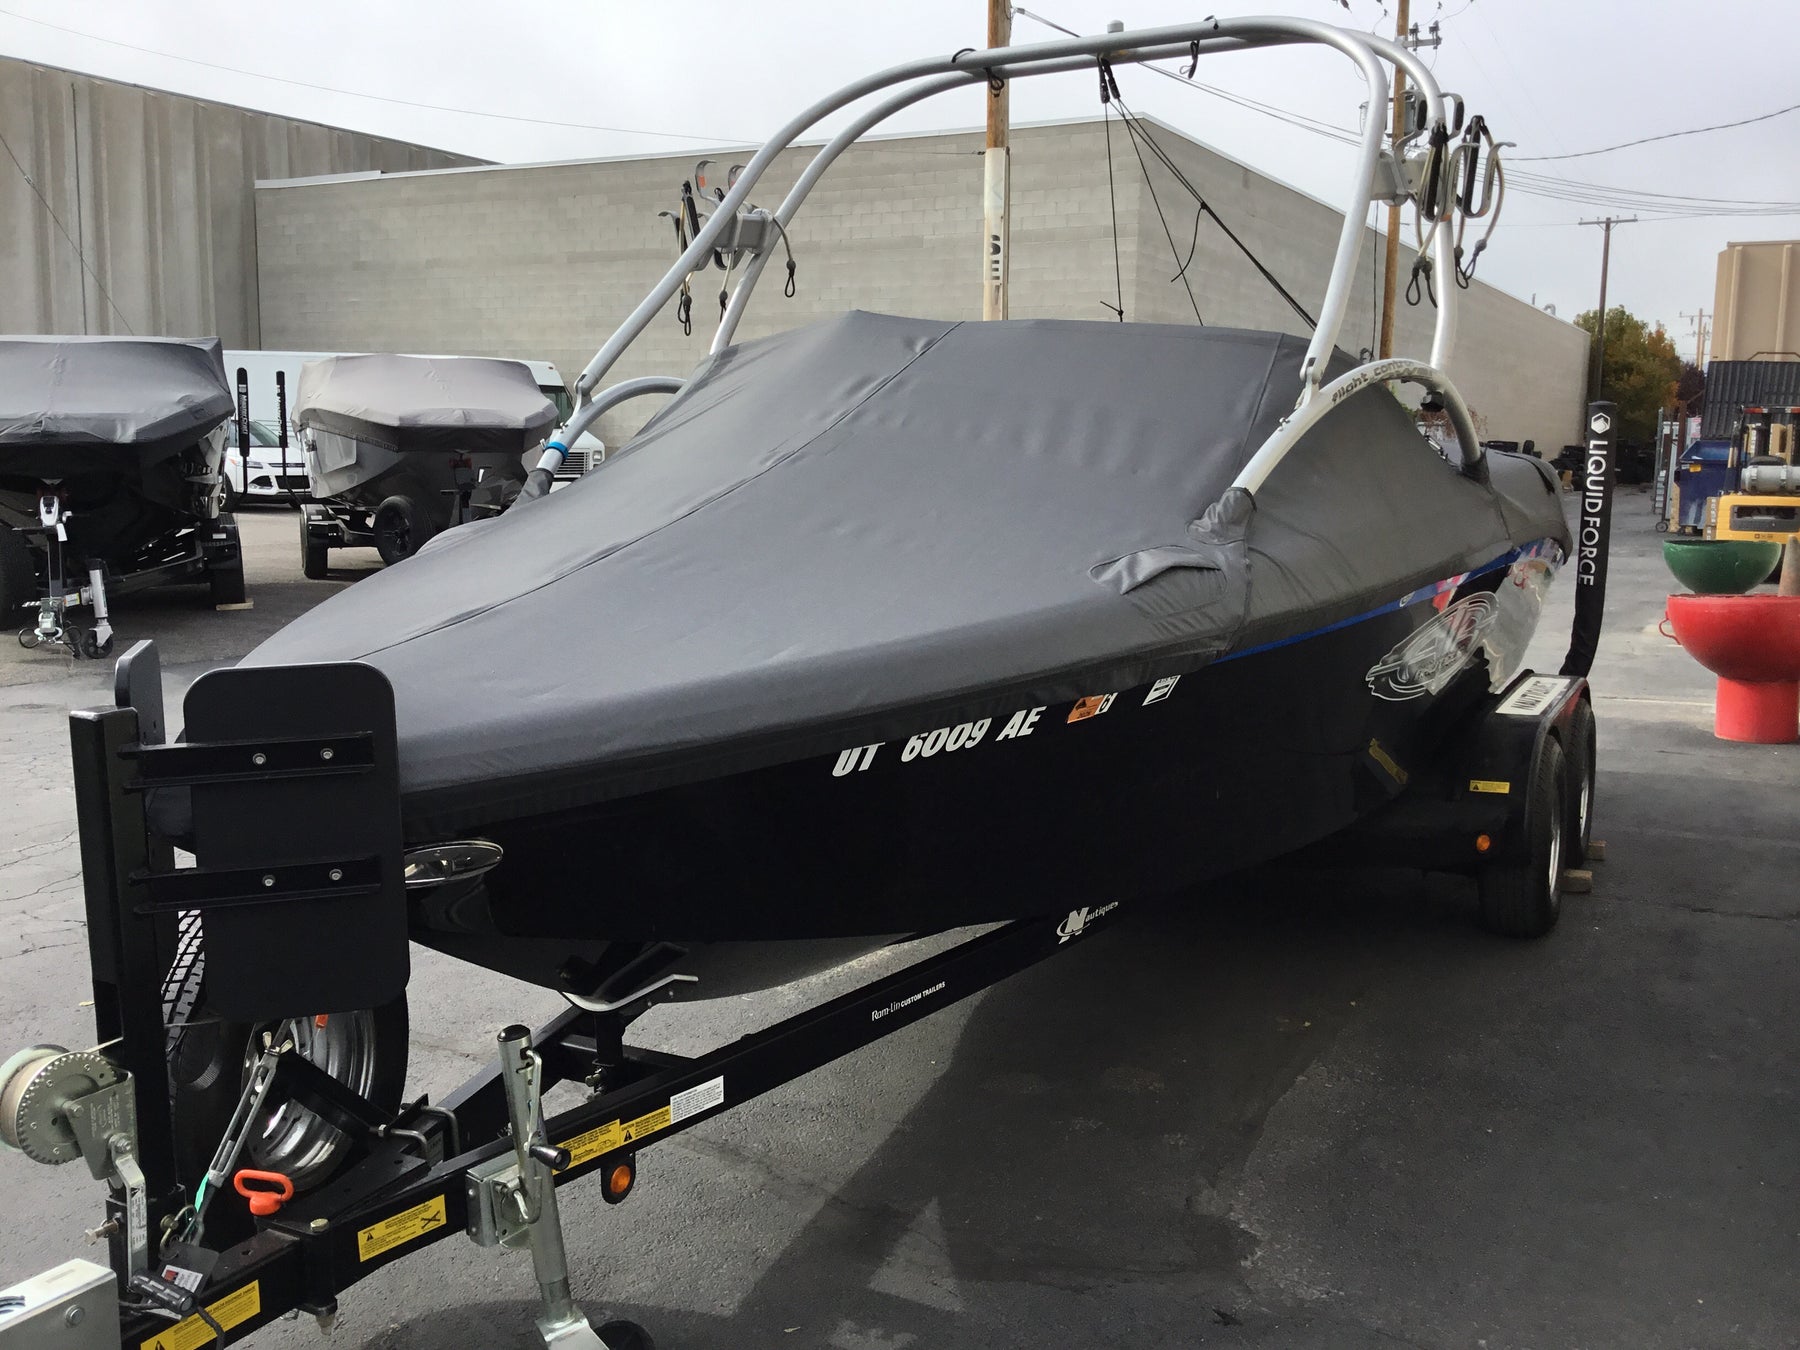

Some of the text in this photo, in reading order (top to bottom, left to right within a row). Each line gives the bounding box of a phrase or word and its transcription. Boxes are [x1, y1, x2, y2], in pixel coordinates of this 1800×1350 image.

[831, 705, 1048, 777] UT 6009 AE
[900, 992, 922, 1008] CUSTOM
[922, 981, 946, 997] TRAILERS
